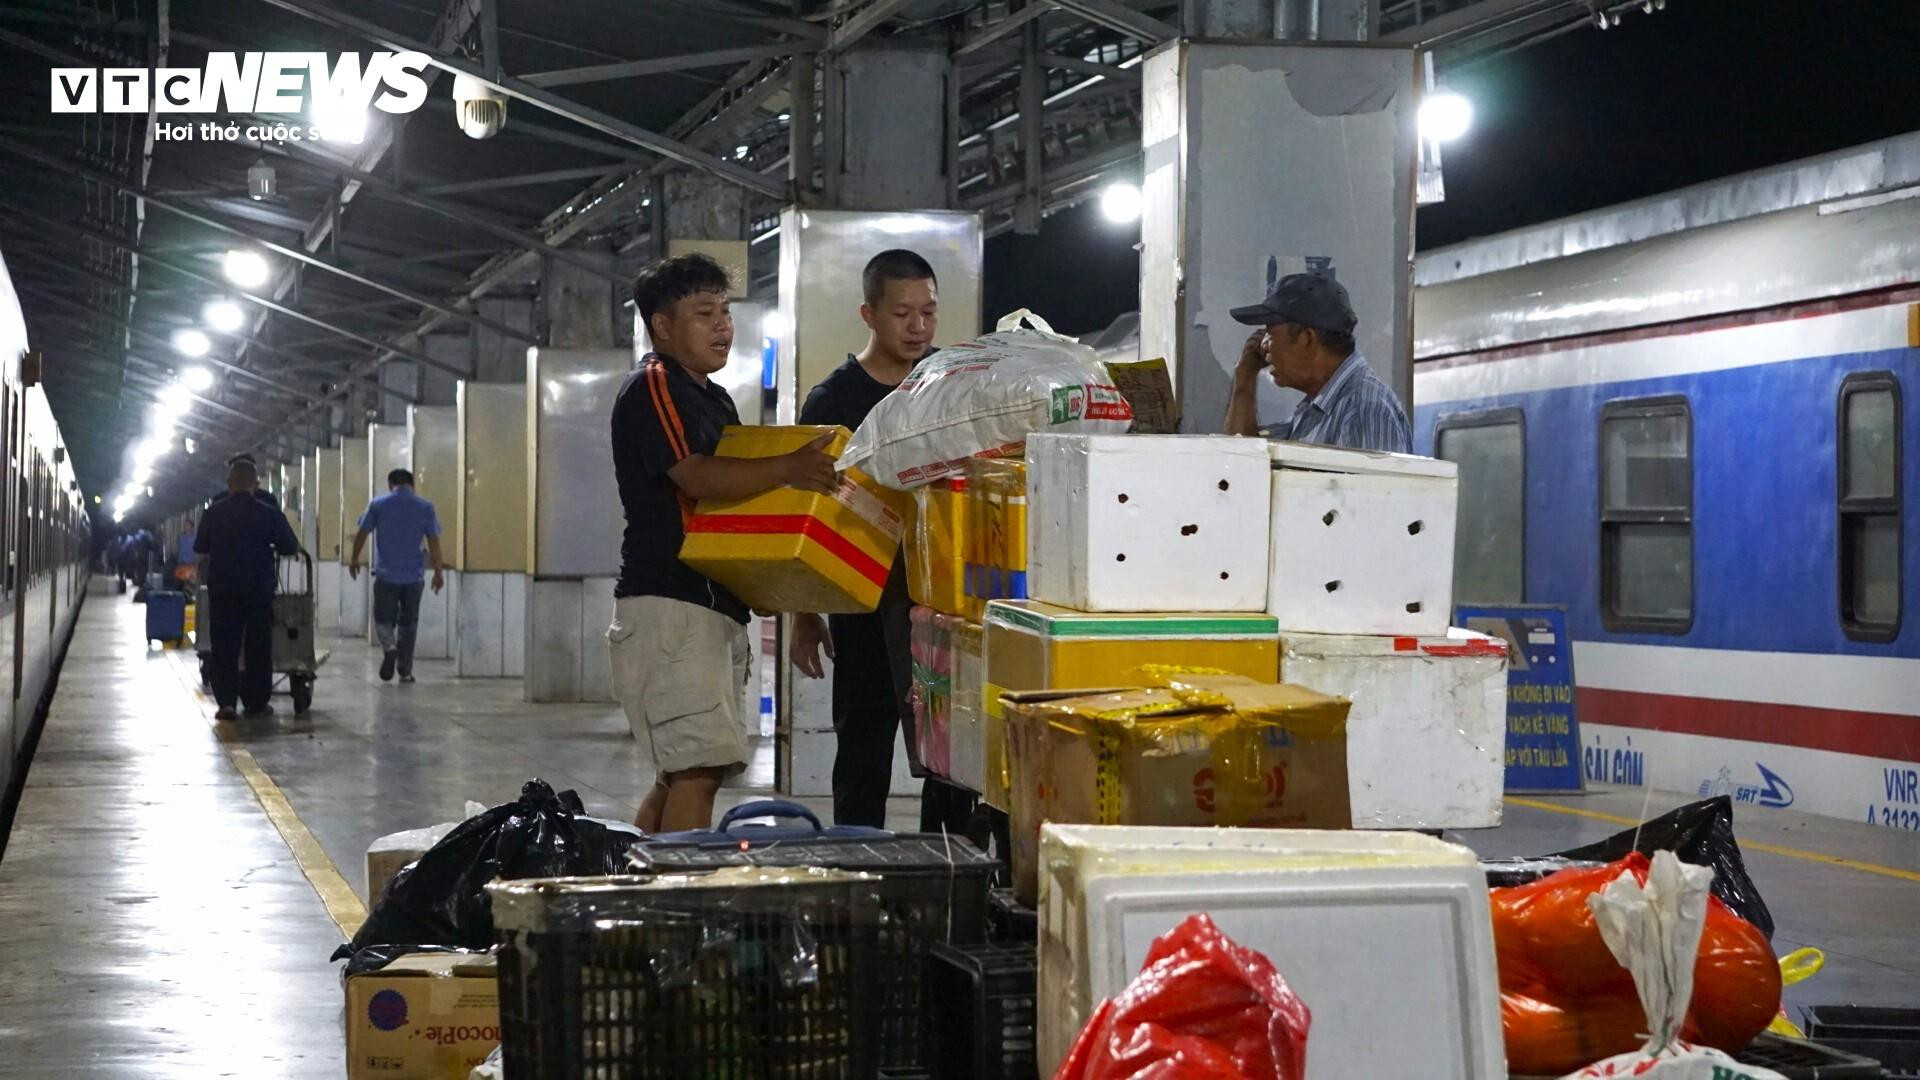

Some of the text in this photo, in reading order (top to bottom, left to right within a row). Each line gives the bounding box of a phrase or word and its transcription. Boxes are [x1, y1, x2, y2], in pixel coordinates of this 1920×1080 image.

[1585, 734, 1643, 785] SÀI GÒN
[1735, 786, 1758, 803] SRT
[1883, 767, 1919, 804] VNR
